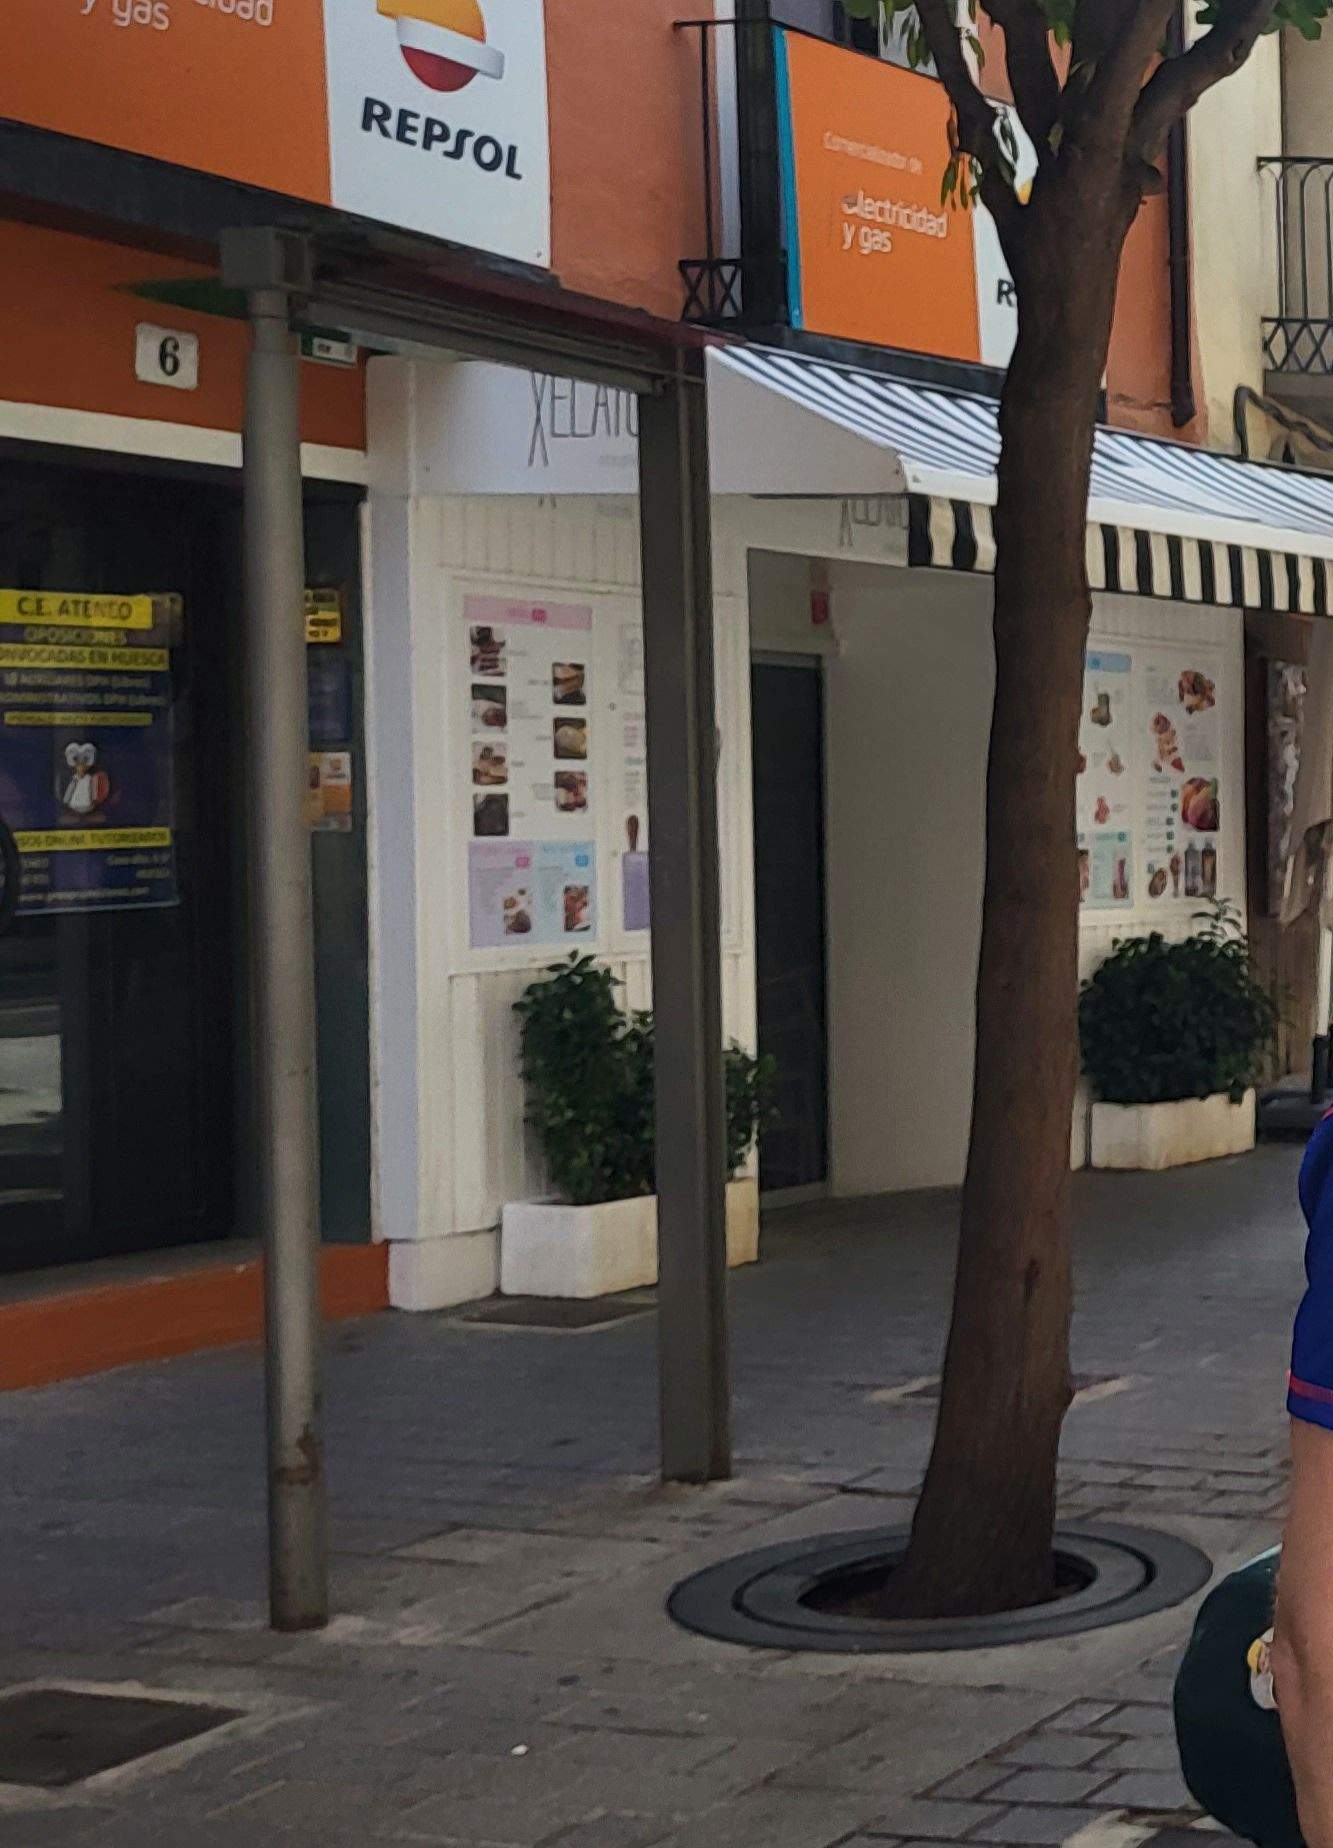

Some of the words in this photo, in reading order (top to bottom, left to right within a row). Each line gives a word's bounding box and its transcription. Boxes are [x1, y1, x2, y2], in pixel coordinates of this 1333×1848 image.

[112, 0, 170, 30] gas
[362, 97, 522, 180] REPSOL
[841, 188, 947, 238] electricidad
[842, 222, 855, 250] y
[859, 226, 892, 254] gas
[996, 279, 1016, 305] R
[158, 337, 181, 376] 6
